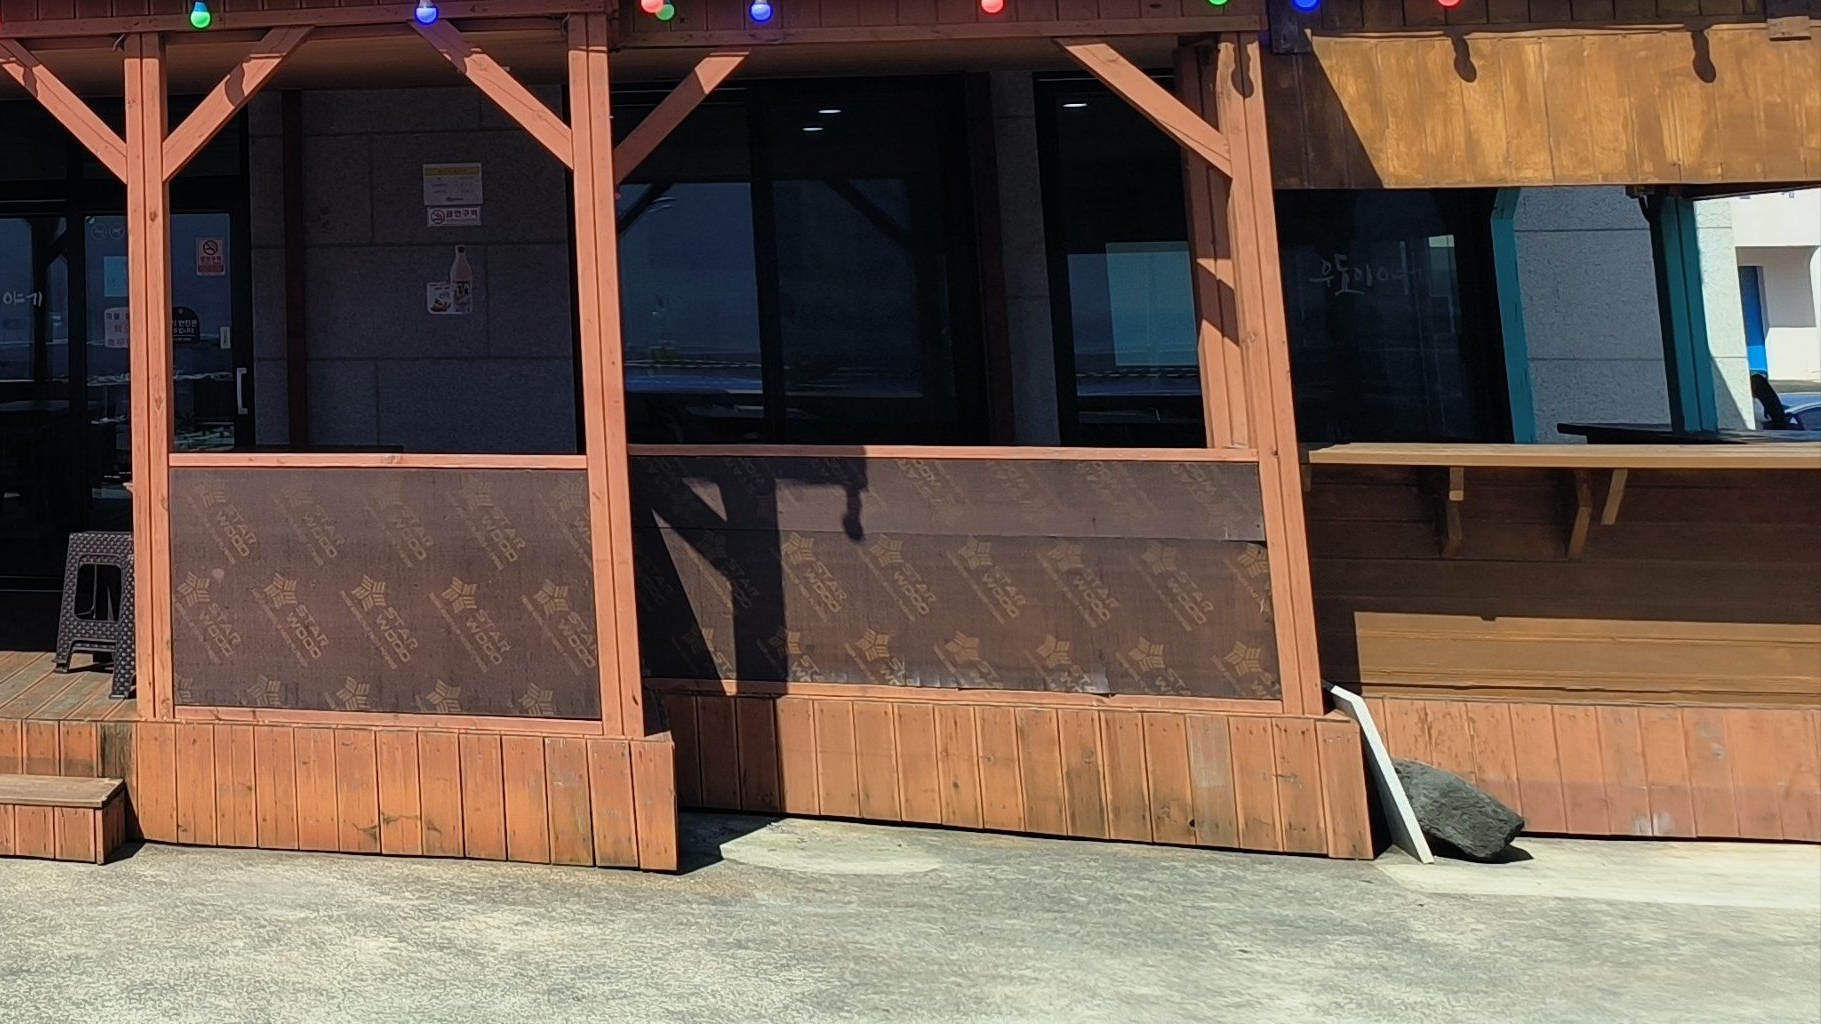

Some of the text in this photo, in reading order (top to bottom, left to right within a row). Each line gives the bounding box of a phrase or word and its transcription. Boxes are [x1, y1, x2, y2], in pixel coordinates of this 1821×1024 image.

[287, 612, 322, 660] WOOD
[295, 604, 330, 648] STAR
[375, 615, 411, 663] WOOD
[385, 607, 420, 650] STAR
[466, 617, 503, 666] WOOD
[476, 609, 511, 653] STAR
